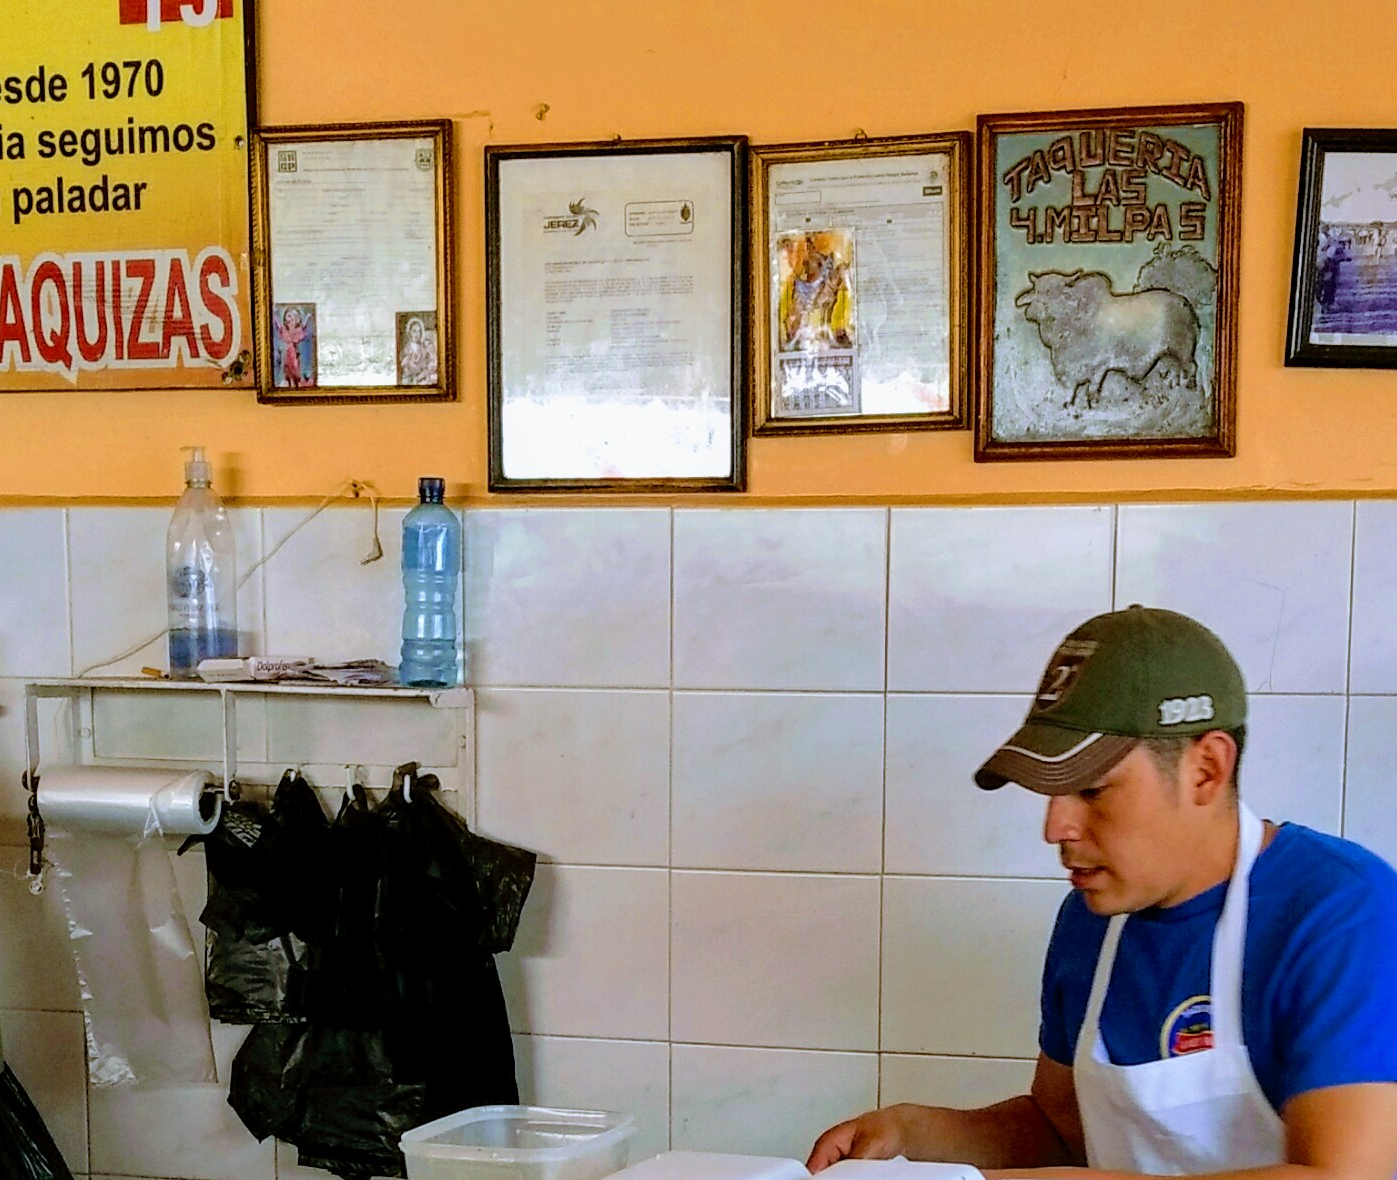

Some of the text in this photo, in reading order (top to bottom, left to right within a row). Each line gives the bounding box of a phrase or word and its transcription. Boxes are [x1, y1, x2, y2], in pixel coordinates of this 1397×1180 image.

[80, 58, 165, 101] 1970
[37, 118, 217, 163] seguimos
[1002, 129, 1211, 202] TAQUERIA
[1071, 169, 1147, 206] LAS
[13, 178, 147, 224] paladar
[544, 219, 579, 229] JEREZ
